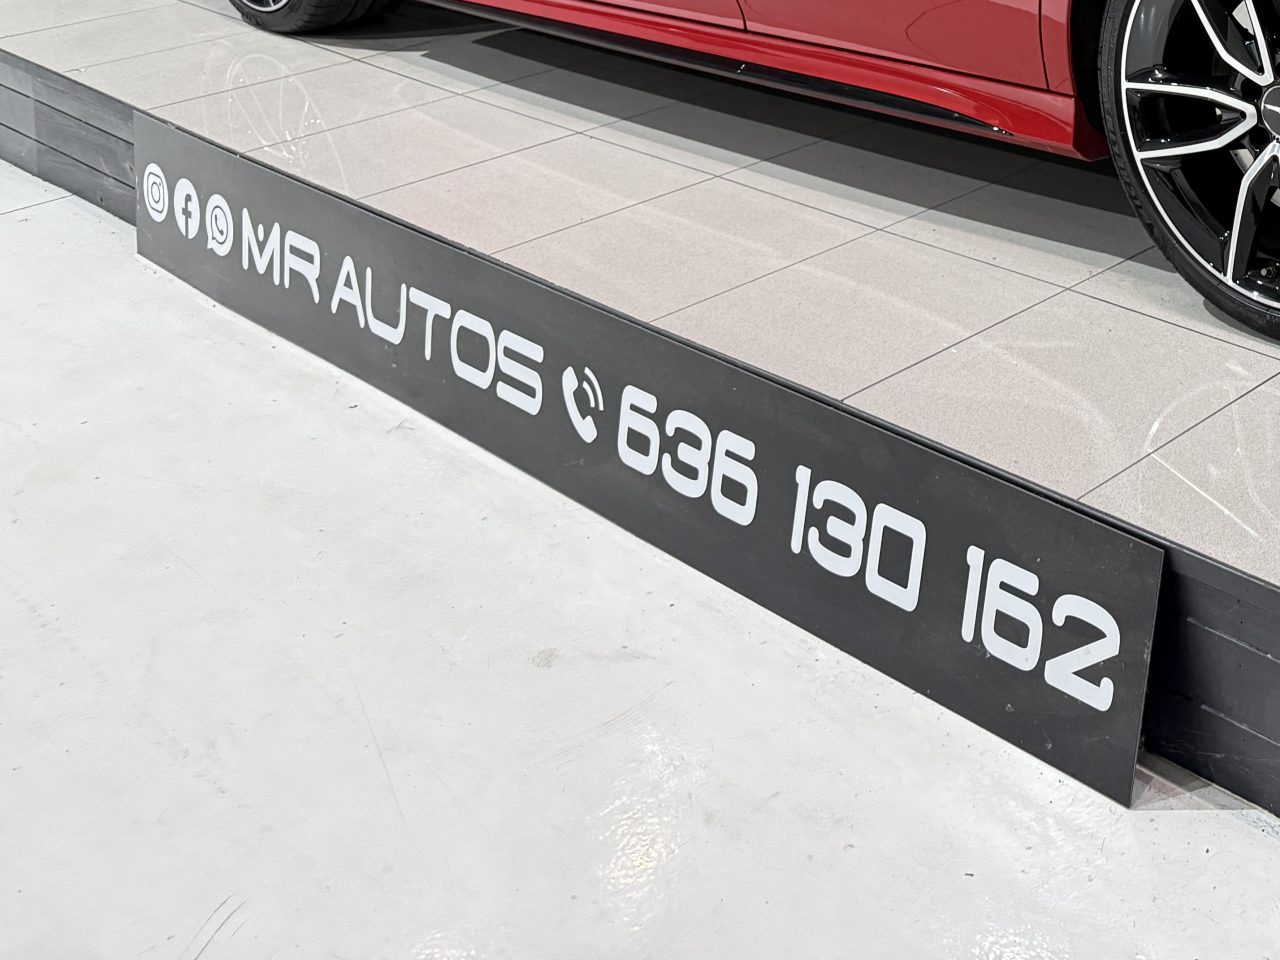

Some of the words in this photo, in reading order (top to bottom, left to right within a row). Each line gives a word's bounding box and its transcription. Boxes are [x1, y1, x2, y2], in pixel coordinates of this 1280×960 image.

[241, 207, 321, 305] MR
[330, 255, 544, 416] AUTOS
[617, 384, 758, 526] 636
[790, 464, 927, 612] 130
[961, 545, 1121, 712] 162
